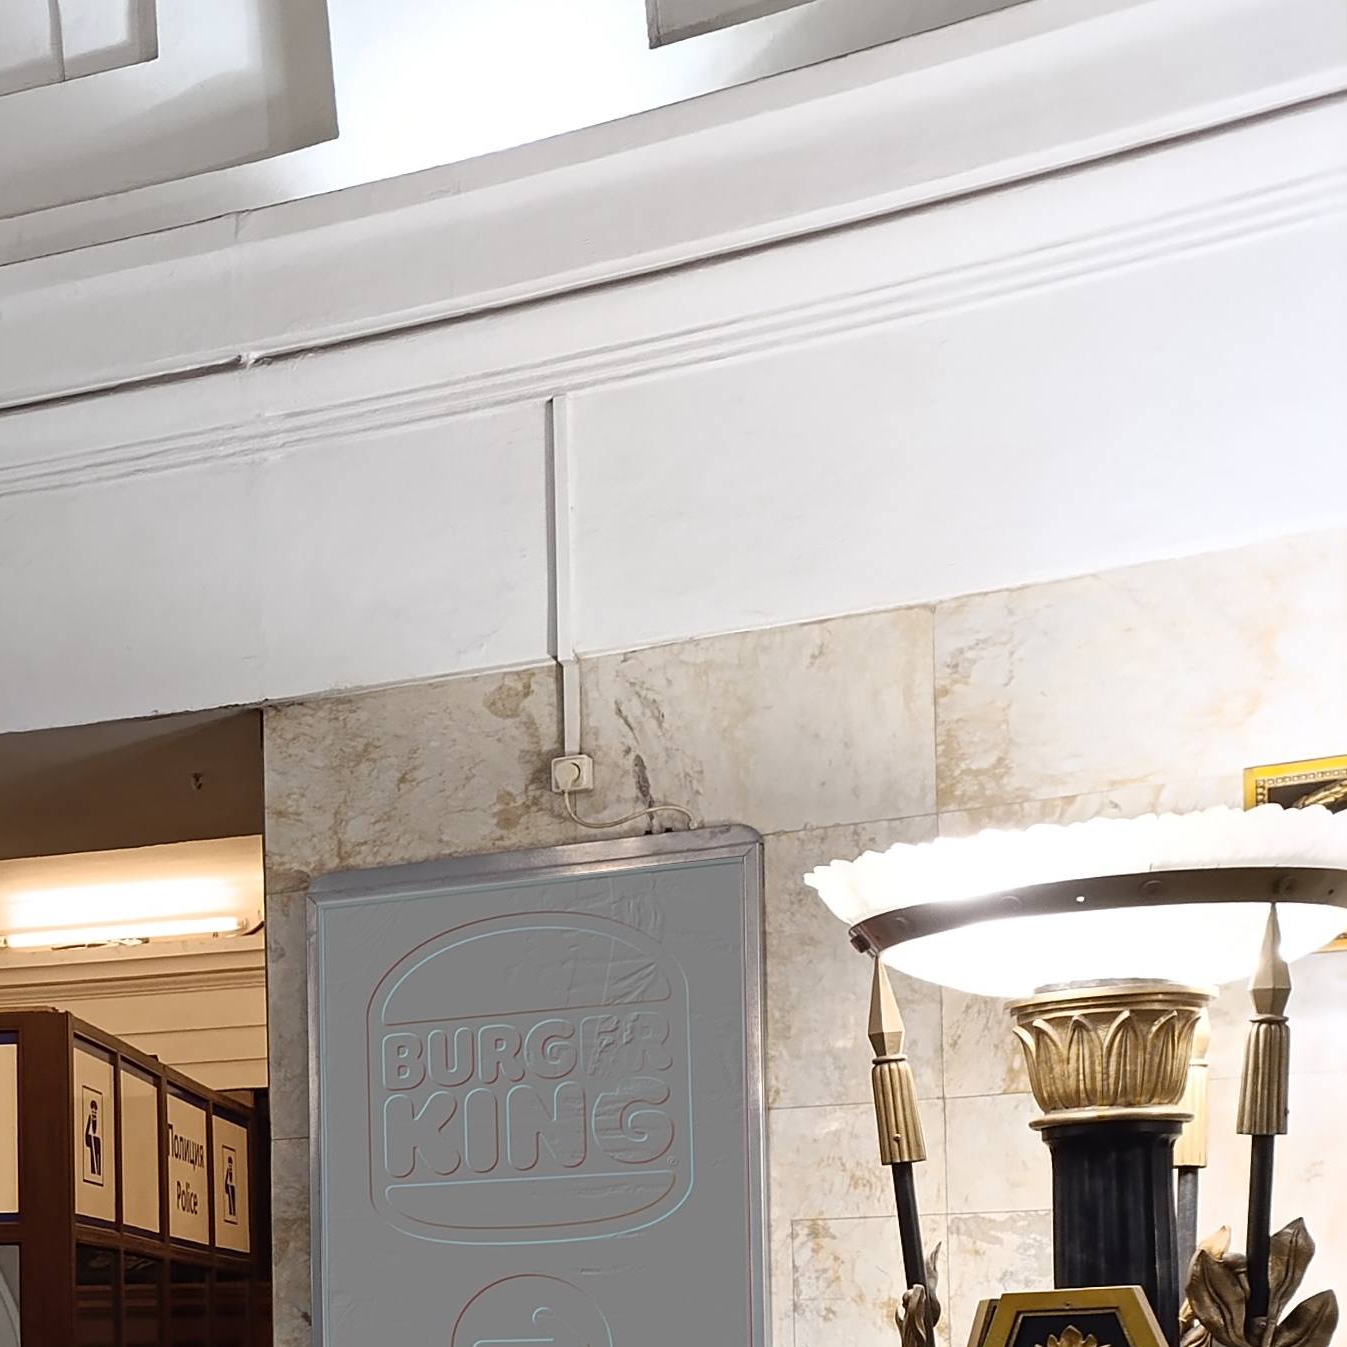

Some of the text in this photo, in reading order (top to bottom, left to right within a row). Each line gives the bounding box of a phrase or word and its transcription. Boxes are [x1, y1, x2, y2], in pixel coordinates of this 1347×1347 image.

[168, 1123, 205, 1171] Полиция
[383, 1076, 675, 1179] KING
[176, 1180, 198, 1216] Police
